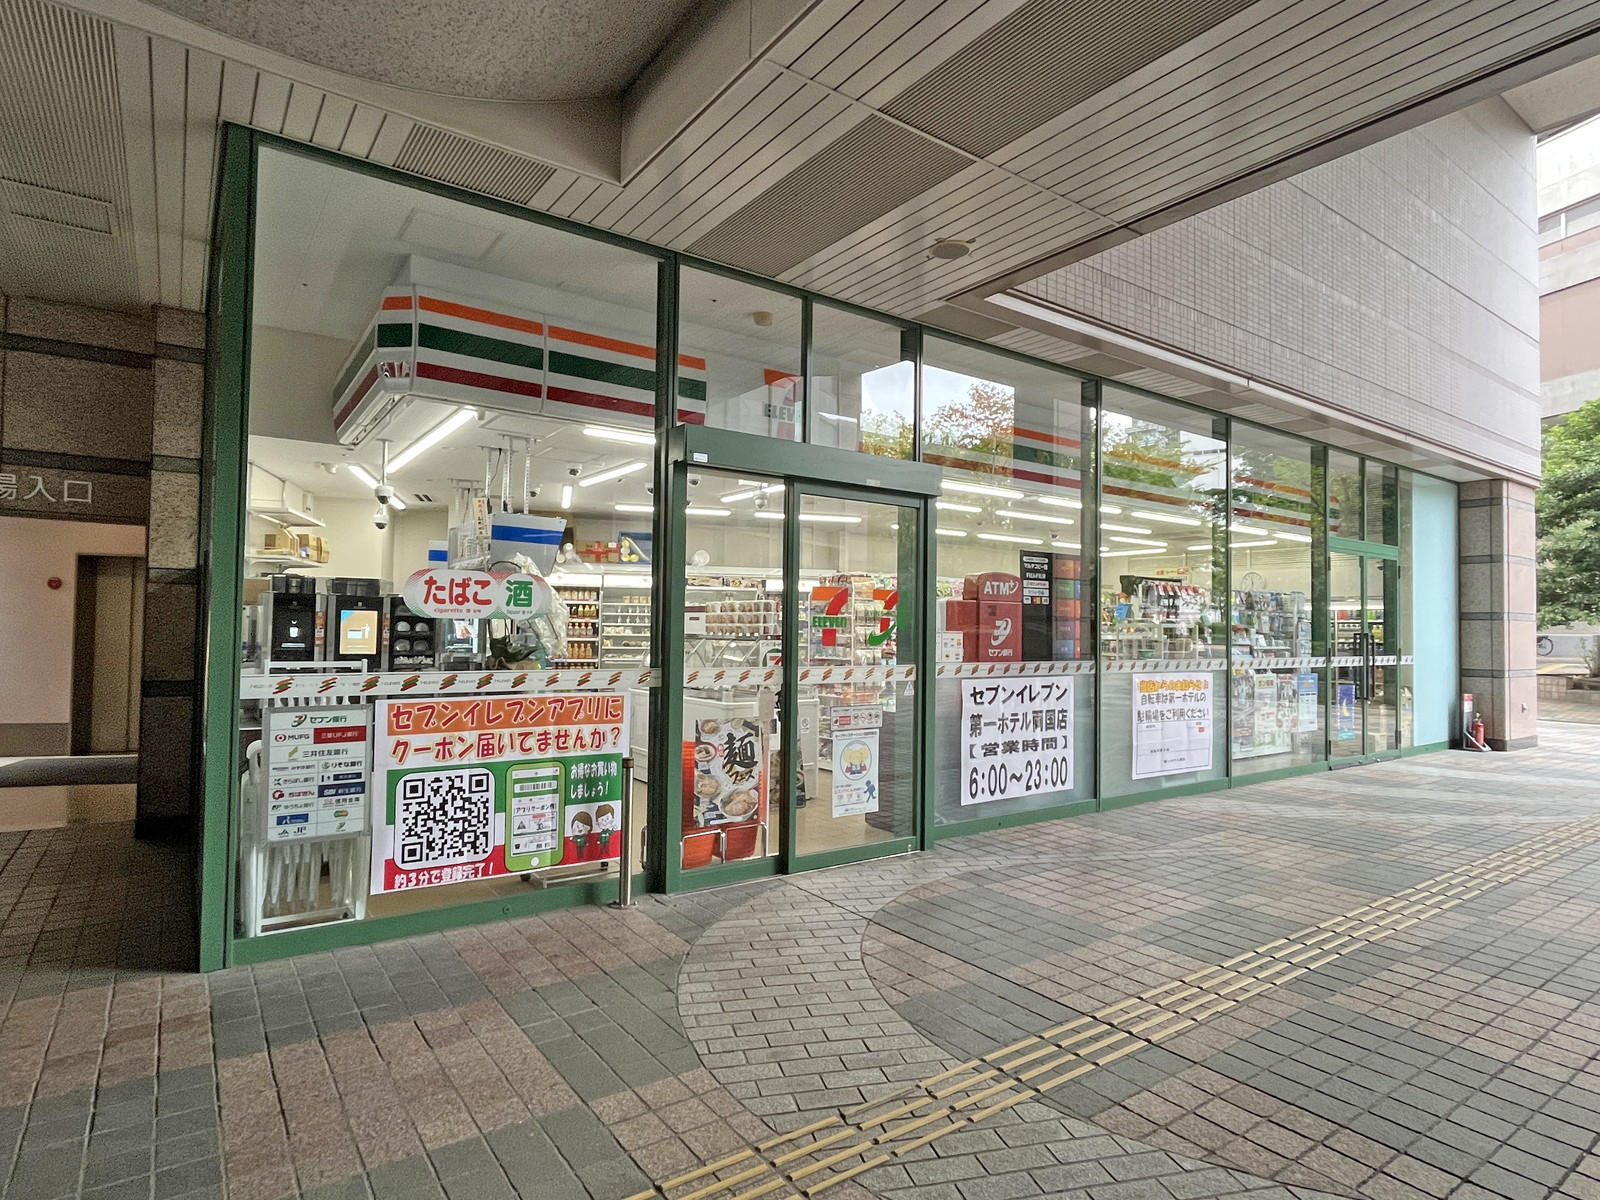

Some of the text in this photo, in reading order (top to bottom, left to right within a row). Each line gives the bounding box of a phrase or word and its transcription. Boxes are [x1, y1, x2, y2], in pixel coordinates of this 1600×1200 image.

[423, 575, 492, 606] たばこ
[505, 579, 534, 608] 酒
[988, 648, 1013, 657] セブン銀行
[970, 682, 1068, 706] セブンイレブン
[1140, 692, 1206, 705] 自転車は第一ホテルの
[310, 715, 347, 724] セブン銀行
[391, 696, 622, 730] セブンイレブンアプリに
[969, 707, 1068, 738] 第一ホテル両国店
[302, 748, 348, 758] 三井住友銀行
[391, 726, 621, 764] クーポン届いてませんか？
[722, 732, 758, 774] 麺
[331, 761, 362, 769] りそな銀行
[570, 762, 617, 780] お得なお買い物
[729, 769, 755, 785] フェス
